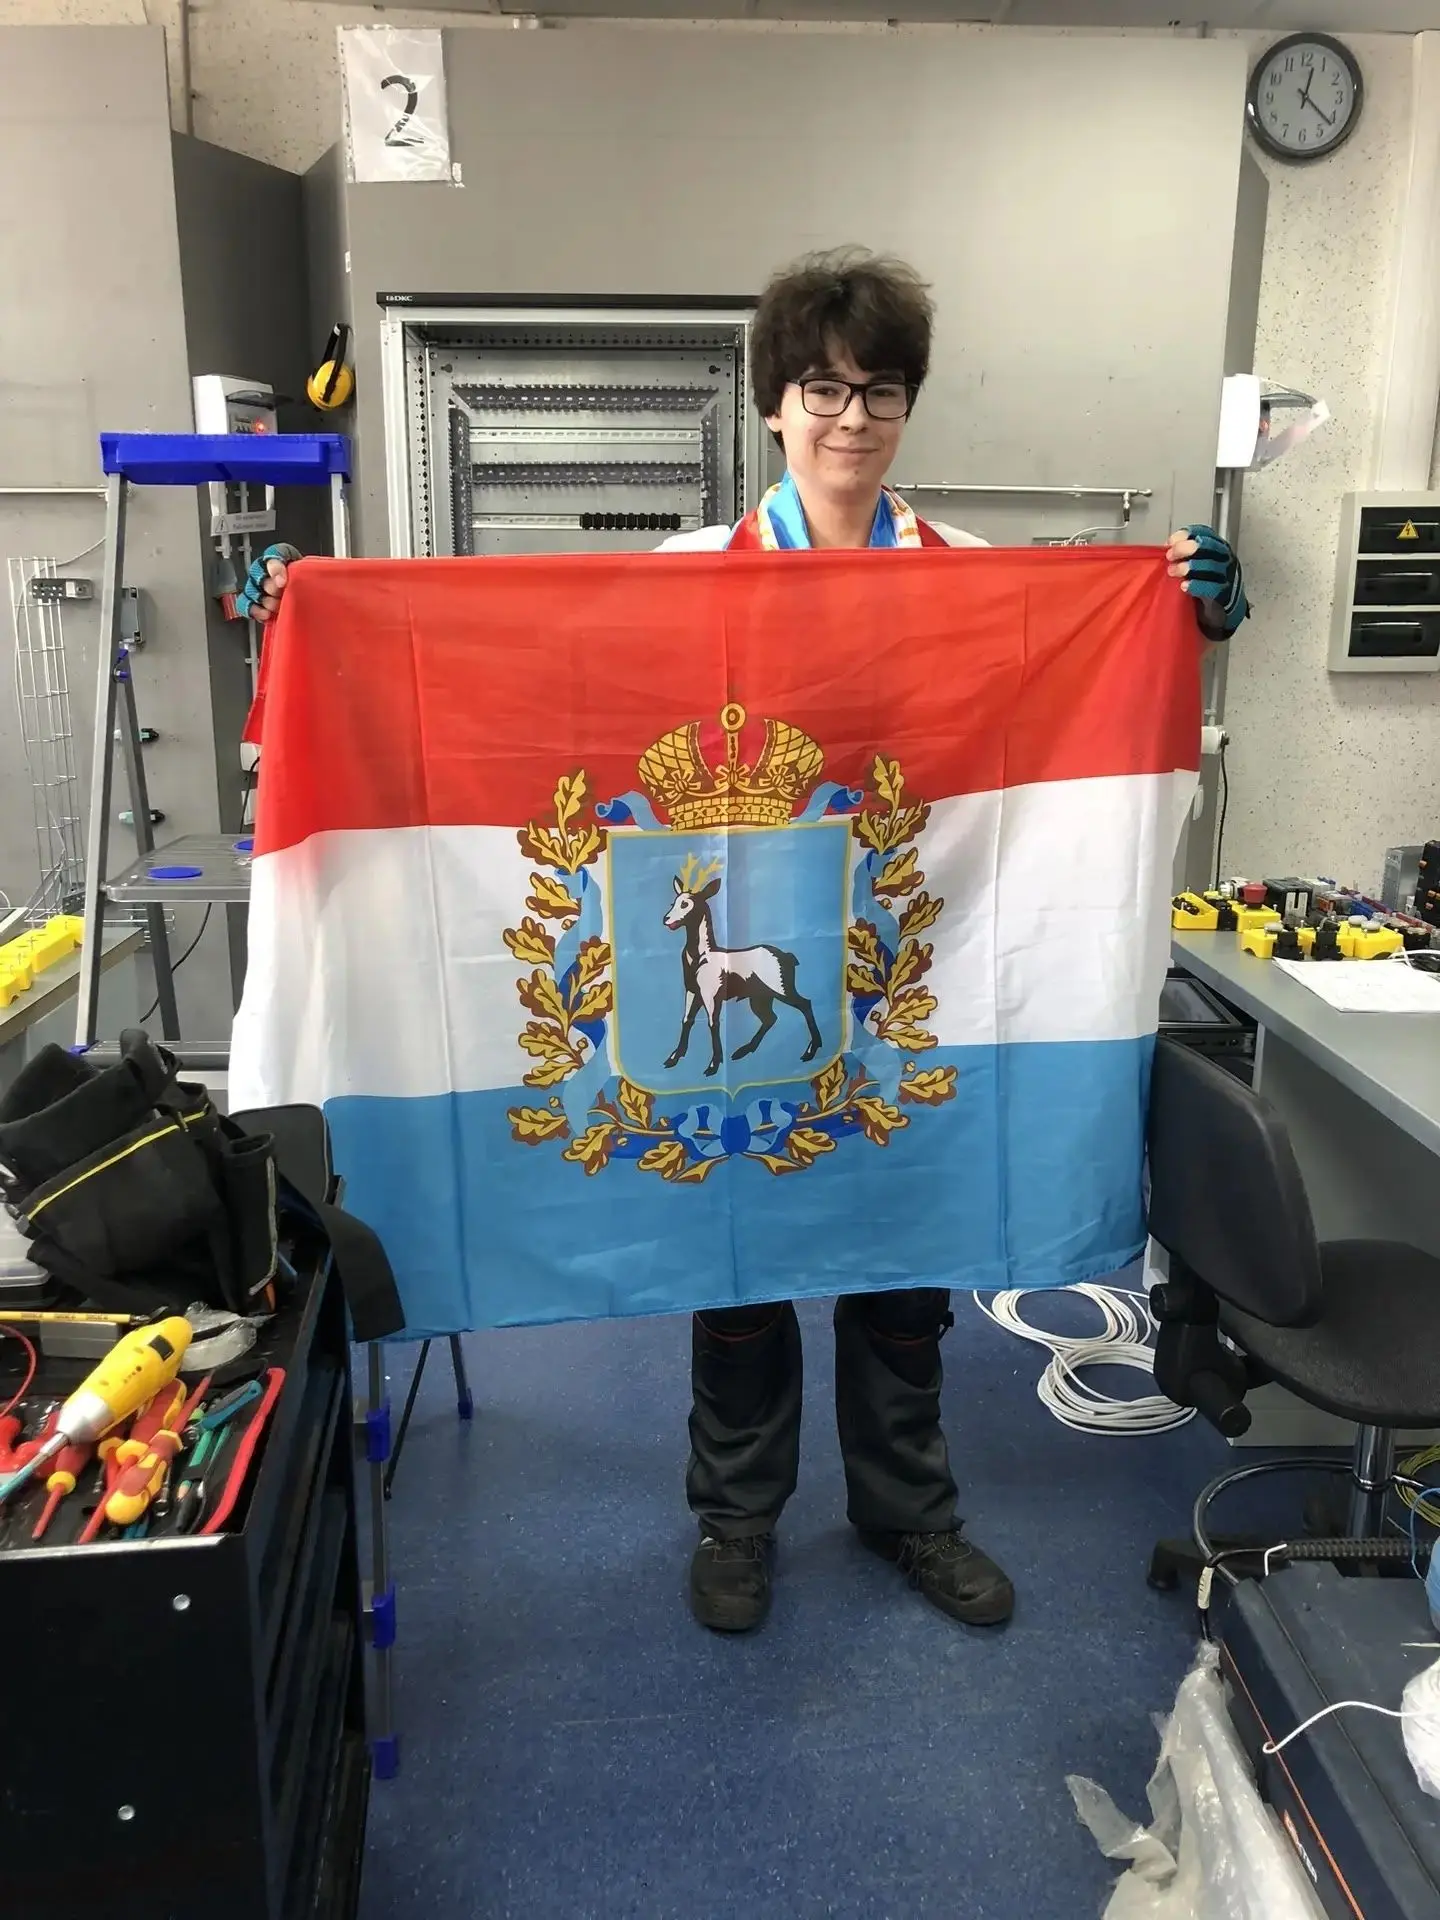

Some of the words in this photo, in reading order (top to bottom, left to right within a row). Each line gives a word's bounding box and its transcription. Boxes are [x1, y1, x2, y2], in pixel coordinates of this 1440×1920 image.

[1284, 56, 1295, 72] 11
[1301, 51, 1314, 67] 12
[1321, 56, 1327, 72] 1
[1270, 72, 1282, 86] 10
[1331, 71, 1340, 86] 2
[1265, 91, 1274, 105] 9
[1335, 90, 1343, 105] 3
[381, 75, 425, 147] 2
[1270, 111, 1278, 123] 8
[1282, 123, 1289, 138] 7
[1298, 128, 1307, 142] 6
[1316, 123, 1324, 138] 5
